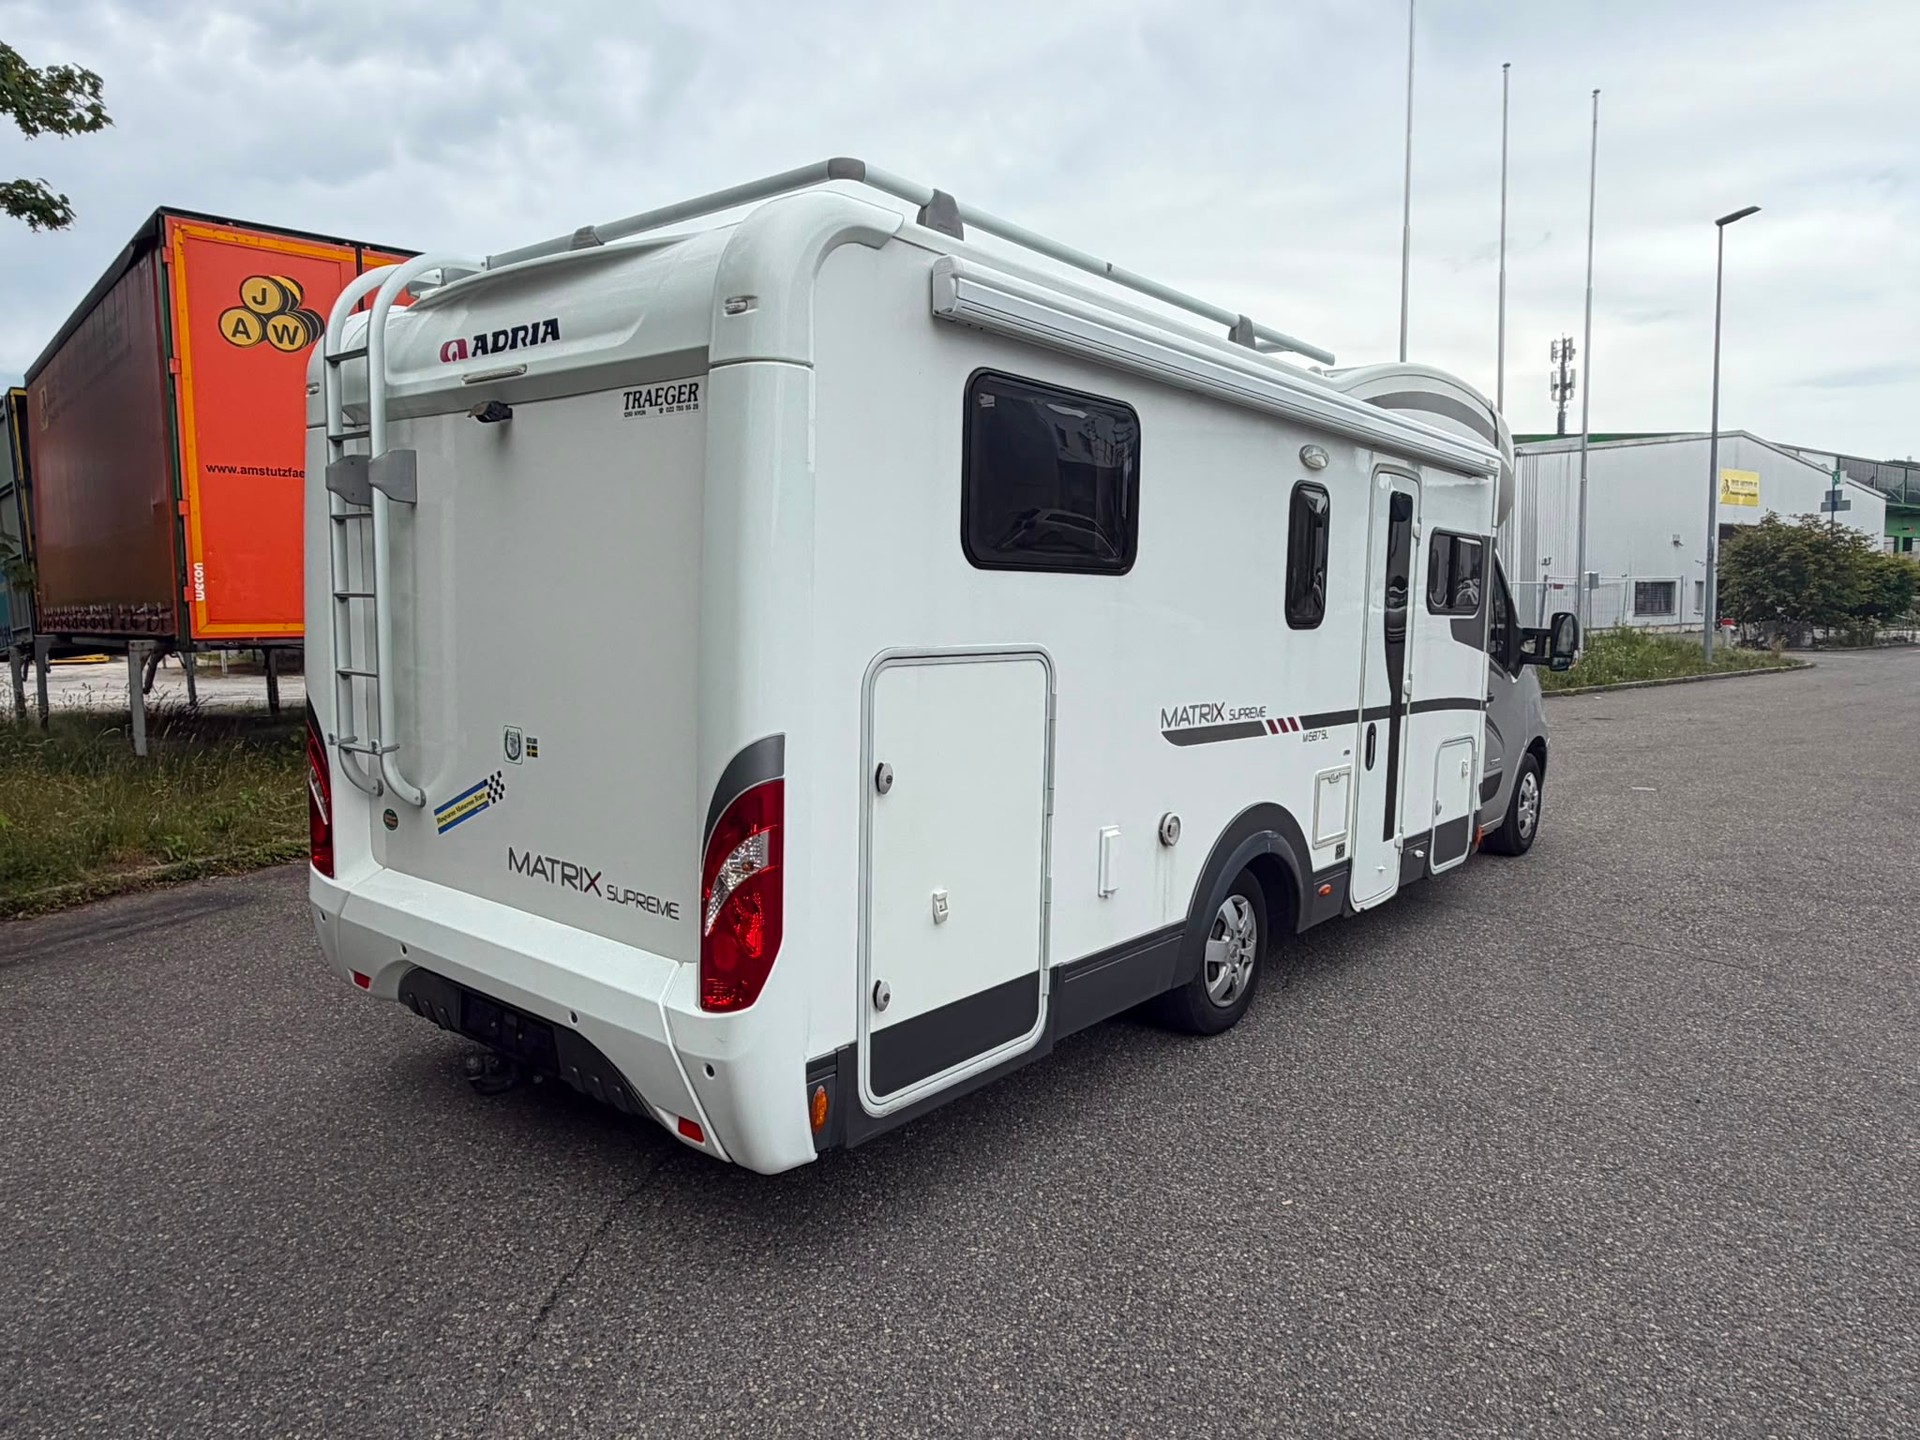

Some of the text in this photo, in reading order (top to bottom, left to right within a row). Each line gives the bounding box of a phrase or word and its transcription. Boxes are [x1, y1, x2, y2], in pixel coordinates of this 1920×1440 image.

[472, 317, 560, 357] ADRIA
[623, 383, 699, 410] TRAEGER
[193, 562, 205, 602] wecon
[1161, 701, 1267, 730] MATRIX SUPREME
[508, 846, 680, 921] MATRIX SUPREME
